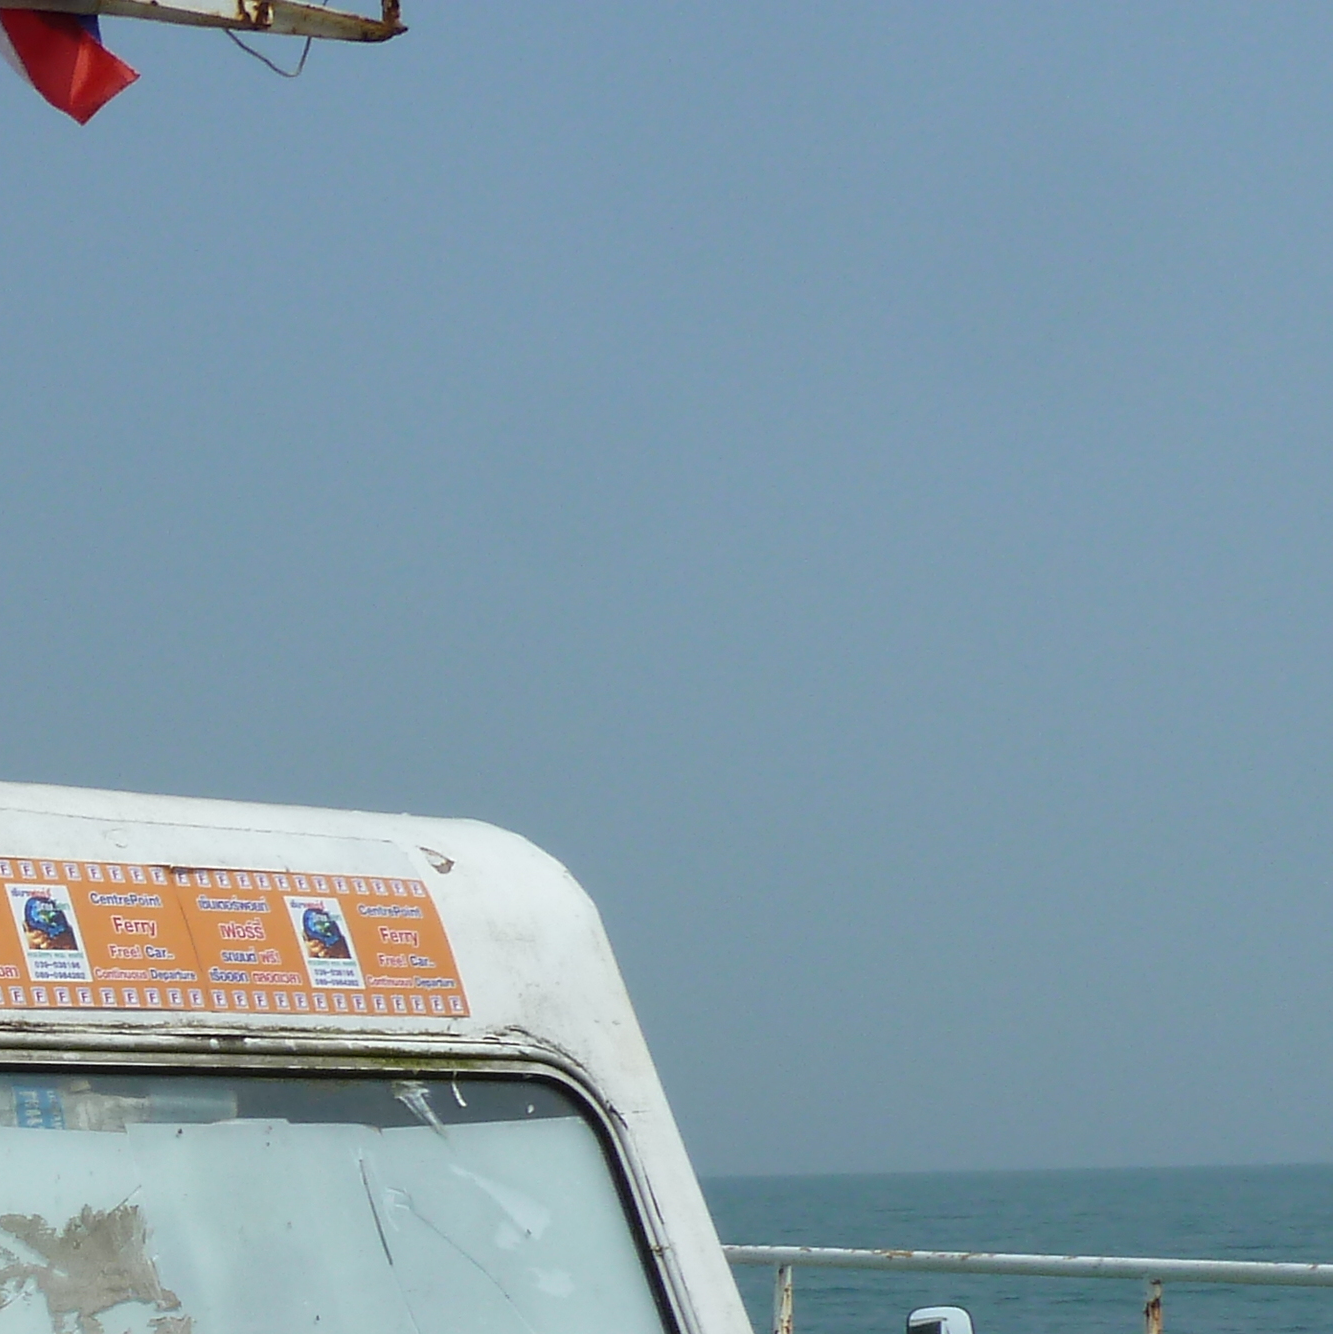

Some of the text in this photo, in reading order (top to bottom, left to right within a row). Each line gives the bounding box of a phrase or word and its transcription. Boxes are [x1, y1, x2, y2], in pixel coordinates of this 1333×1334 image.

[90, 892, 162, 907] CentrePoint
[113, 916, 156, 937] Ferry
[379, 927, 418, 947] Ferry
[109, 945, 142, 958] Free!
[95, 968, 196, 981] Continuous Departure
